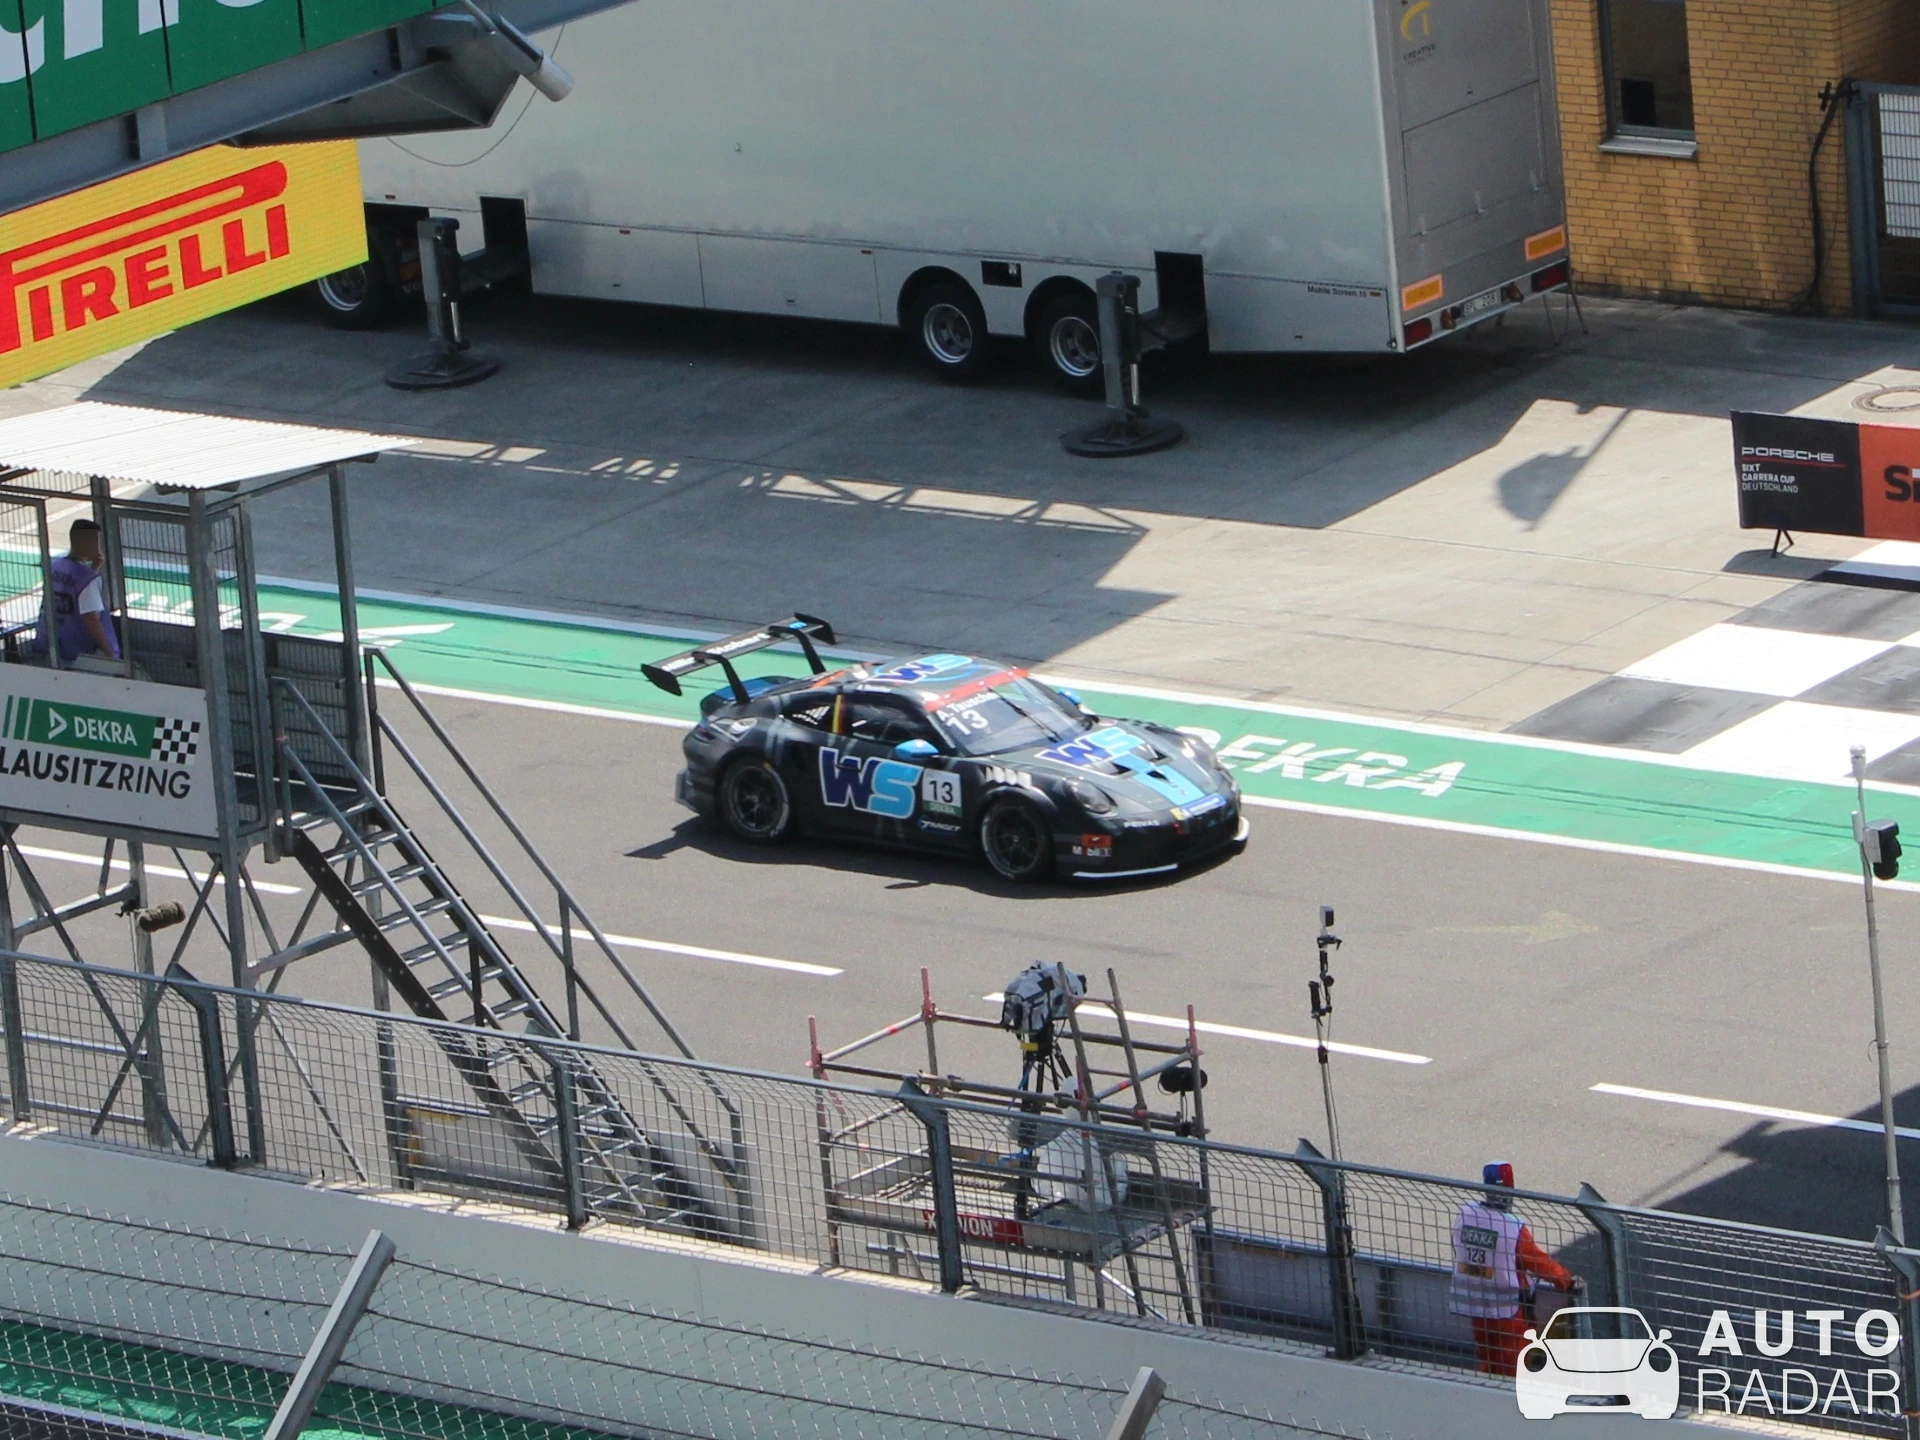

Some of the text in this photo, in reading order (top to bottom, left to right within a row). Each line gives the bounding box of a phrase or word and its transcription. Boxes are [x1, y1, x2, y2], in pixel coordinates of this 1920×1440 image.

[0, 160, 291, 354] PIRELLI
[1741, 446, 1835, 463] PORSCHE
[1741, 463, 1761, 472] SIXT
[1741, 473, 1796, 484] CARRERA CUP
[1741, 482, 1799, 494] DEUTSCHLAND
[74, 716, 138, 747] DEKRA
[946, 709, 989, 735] 13
[0, 746, 191, 800] LAUSITZRING
[929, 780, 954, 804] 13
[1466, 1247, 1486, 1265] 123
